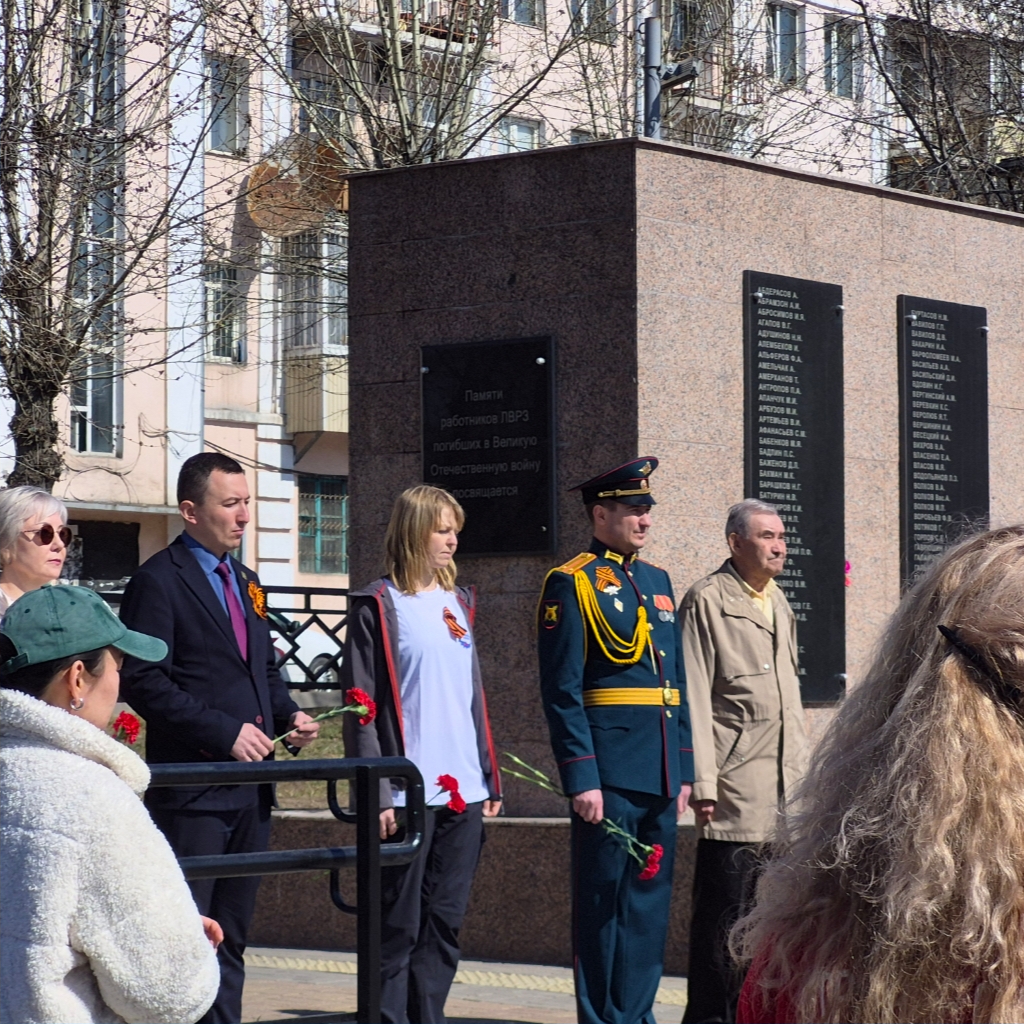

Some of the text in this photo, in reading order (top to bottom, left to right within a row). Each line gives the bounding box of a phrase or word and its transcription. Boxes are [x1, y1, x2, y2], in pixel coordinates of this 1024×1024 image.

[758, 308, 793, 319] АБРОСИМОВ
[911, 330, 935, 339] ВАВИЛОВ
[758, 351, 789, 361] АЛЬФЕРОВ
[912, 350, 949, 361] ВАРФОЛОМЕЕВ
[912, 360, 938, 369] ВАСИЛЬЕВ
[758, 383, 789, 393] АНТРОПОВ
[465, 389, 504, 402] Памяти
[758, 405, 785, 414] АРБУЗОВ
[440, 410, 529, 430] работников ЛВРЗ
[758, 416, 789, 425] АРТЕМЬЕВ
[759, 426, 793, 436] АФАНАСЬЕВ
[433, 434, 537, 452] погибших в Великую
[759, 437, 789, 447] БАБЕНКОВ
[913, 451, 940, 460] ВЛАСЕНКО
[430, 458, 541, 476] Отечественную войну
[759, 459, 787, 468] БАЖЕНОВ
[452, 486, 518, 499] посвящается
